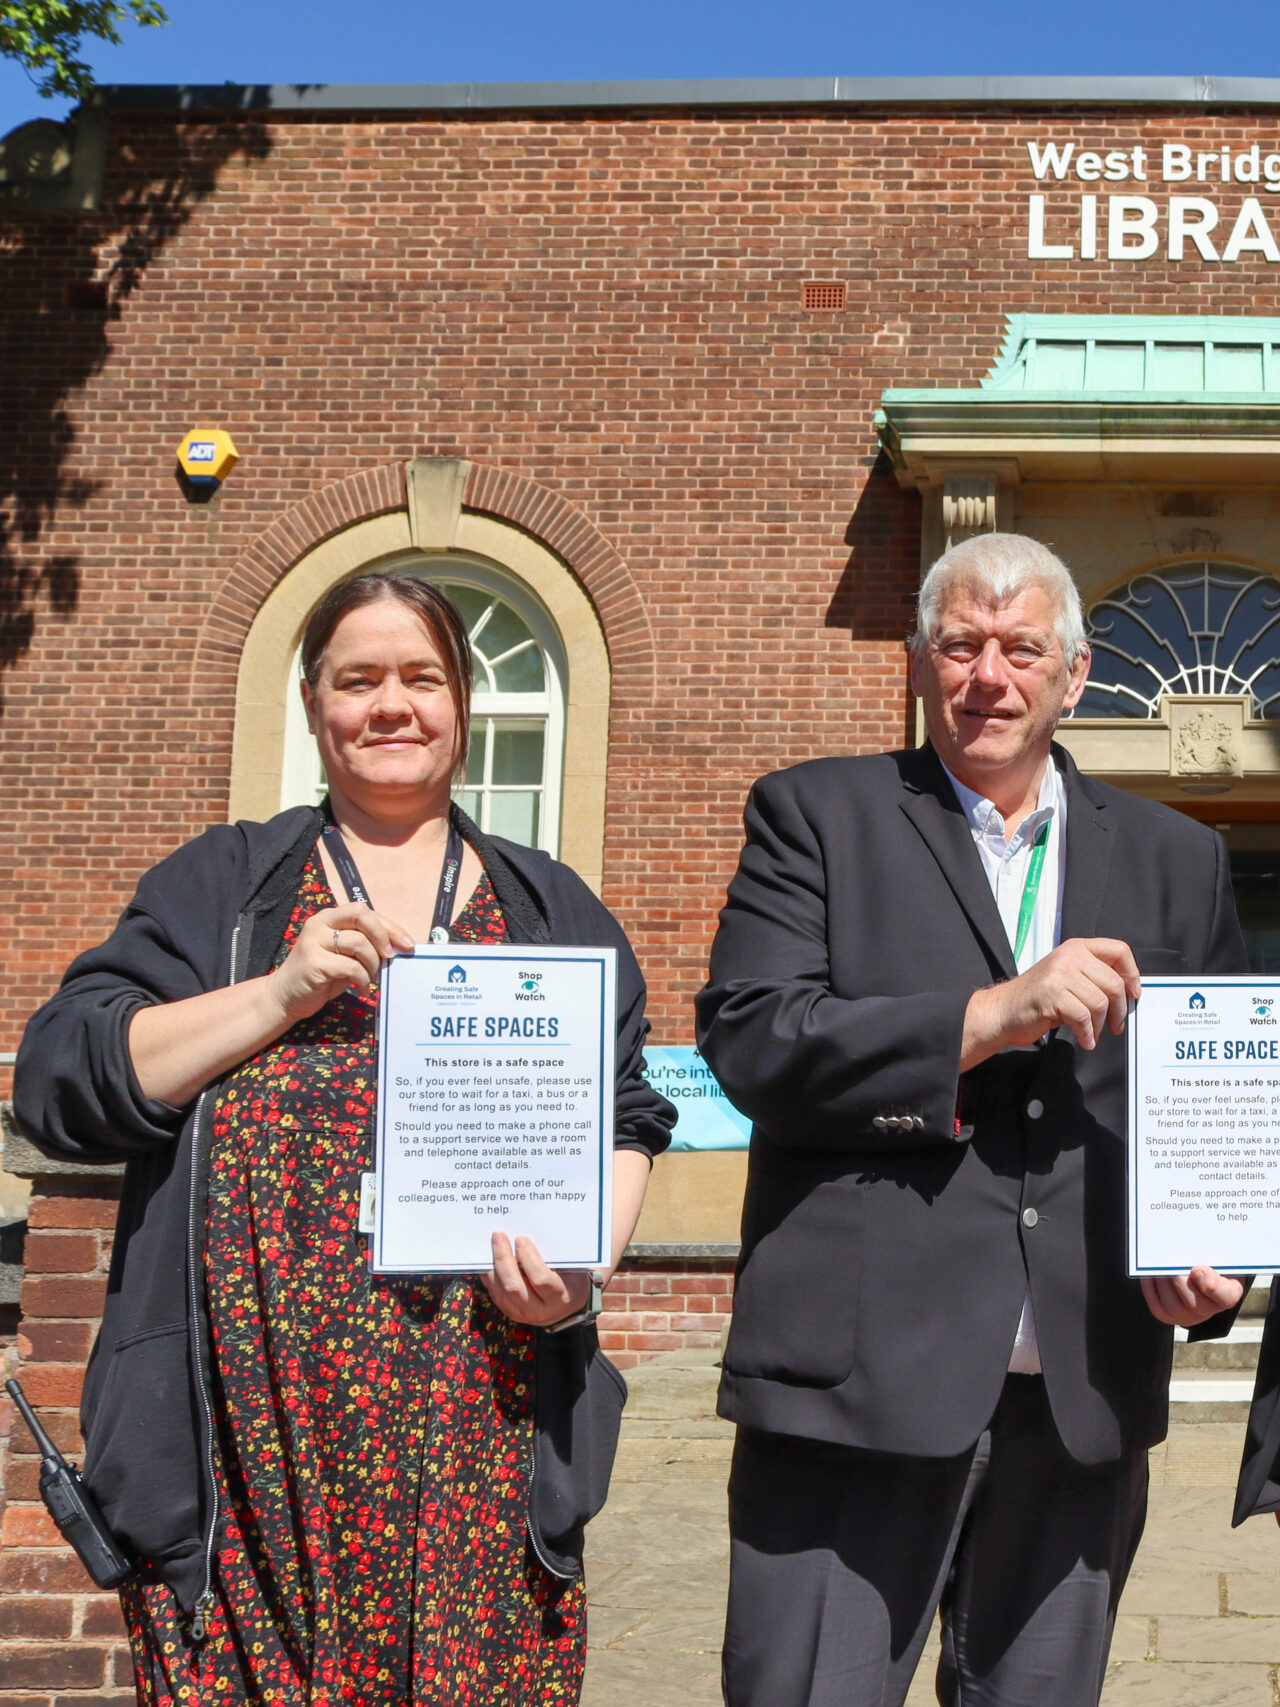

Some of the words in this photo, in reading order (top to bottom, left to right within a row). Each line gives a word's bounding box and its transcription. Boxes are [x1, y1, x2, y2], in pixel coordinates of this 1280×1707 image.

[1027, 141, 1148, 182] West
[189, 443, 214, 459] ADT
[443, 866, 457, 893] Inspire
[518, 971, 542, 981] Shop
[514, 991, 545, 1000] Watch
[1251, 997, 1274, 1006] Shop
[430, 1016, 477, 1037] SAFE
[484, 1016, 558, 1037] SPACES
[1249, 1016, 1277, 1025] Watch
[1175, 1040, 1217, 1059] SAFE
[424, 1057, 447, 1066] This
[451, 1058, 479, 1066] store
[482, 1057, 492, 1066] is
[505, 1057, 528, 1066] safe
[531, 1059, 564, 1068] space
[641, 1065, 687, 1079] ou're
[395, 1076, 412, 1086] So,
[416, 1076, 423, 1085] if
[425, 1078, 444, 1087] you
[473, 1076, 492, 1085] feel
[495, 1075, 532, 1085] unsafe,
[536, 1076, 570, 1087] please
[573, 1077, 592, 1085] use
[1170, 1078, 1191, 1086] This
[1222, 1078, 1231, 1086] is
[1242, 1077, 1263, 1086] safe
[419, 1090, 445, 1098] store
[448, 1089, 458, 1098] to
[461, 1089, 482, 1098] wait
[485, 1088, 499, 1098] for
[511, 1088, 532, 1099] taxi,
[546, 1088, 564, 1098] bus
[665, 1084, 707, 1098] local
[1144, 1095, 1160, 1104] So,
[1163, 1095, 1169, 1104] if
[1171, 1097, 1188, 1105] you
[1214, 1094, 1231, 1103] feel
[1234, 1094, 1267, 1104] unsafe,
[408, 1102, 438, 1111] friend
[441, 1102, 455, 1111] for
[473, 1102, 495, 1113] long
[514, 1103, 533, 1113] you
[536, 1101, 561, 1111] need
[565, 1101, 578, 1110] to.
[394, 1121, 430, 1131] Should
[434, 1123, 452, 1132] you
[456, 1120, 481, 1130] need
[485, 1121, 494, 1130] to
[497, 1120, 526, 1129] make
[538, 1120, 570, 1131] phone
[573, 1119, 591, 1129] call
[399, 1135, 409, 1144] to
[422, 1134, 461, 1145] support
[464, 1134, 501, 1143] service
[522, 1133, 547, 1142] have
[560, 1134, 586, 1142] room
[403, 1147, 423, 1157] and
[426, 1147, 478, 1158] telephone
[481, 1146, 527, 1156] available
[545, 1146, 565, 1155] well
[569, 1147, 581, 1155] as
[454, 1160, 492, 1169] contact
[494, 1159, 531, 1169] details.
[421, 1179, 457, 1188] Please
[460, 1178, 508, 1190] approach
[534, 1177, 544, 1187] of
[547, 1179, 564, 1187] our
[397, 1193, 457, 1204] colleagues,
[479, 1193, 496, 1201] are
[529, 1191, 551, 1200] than
[554, 1190, 585, 1201] happy
[473, 1205, 483, 1214] to
[486, 1204, 511, 1215] help.
